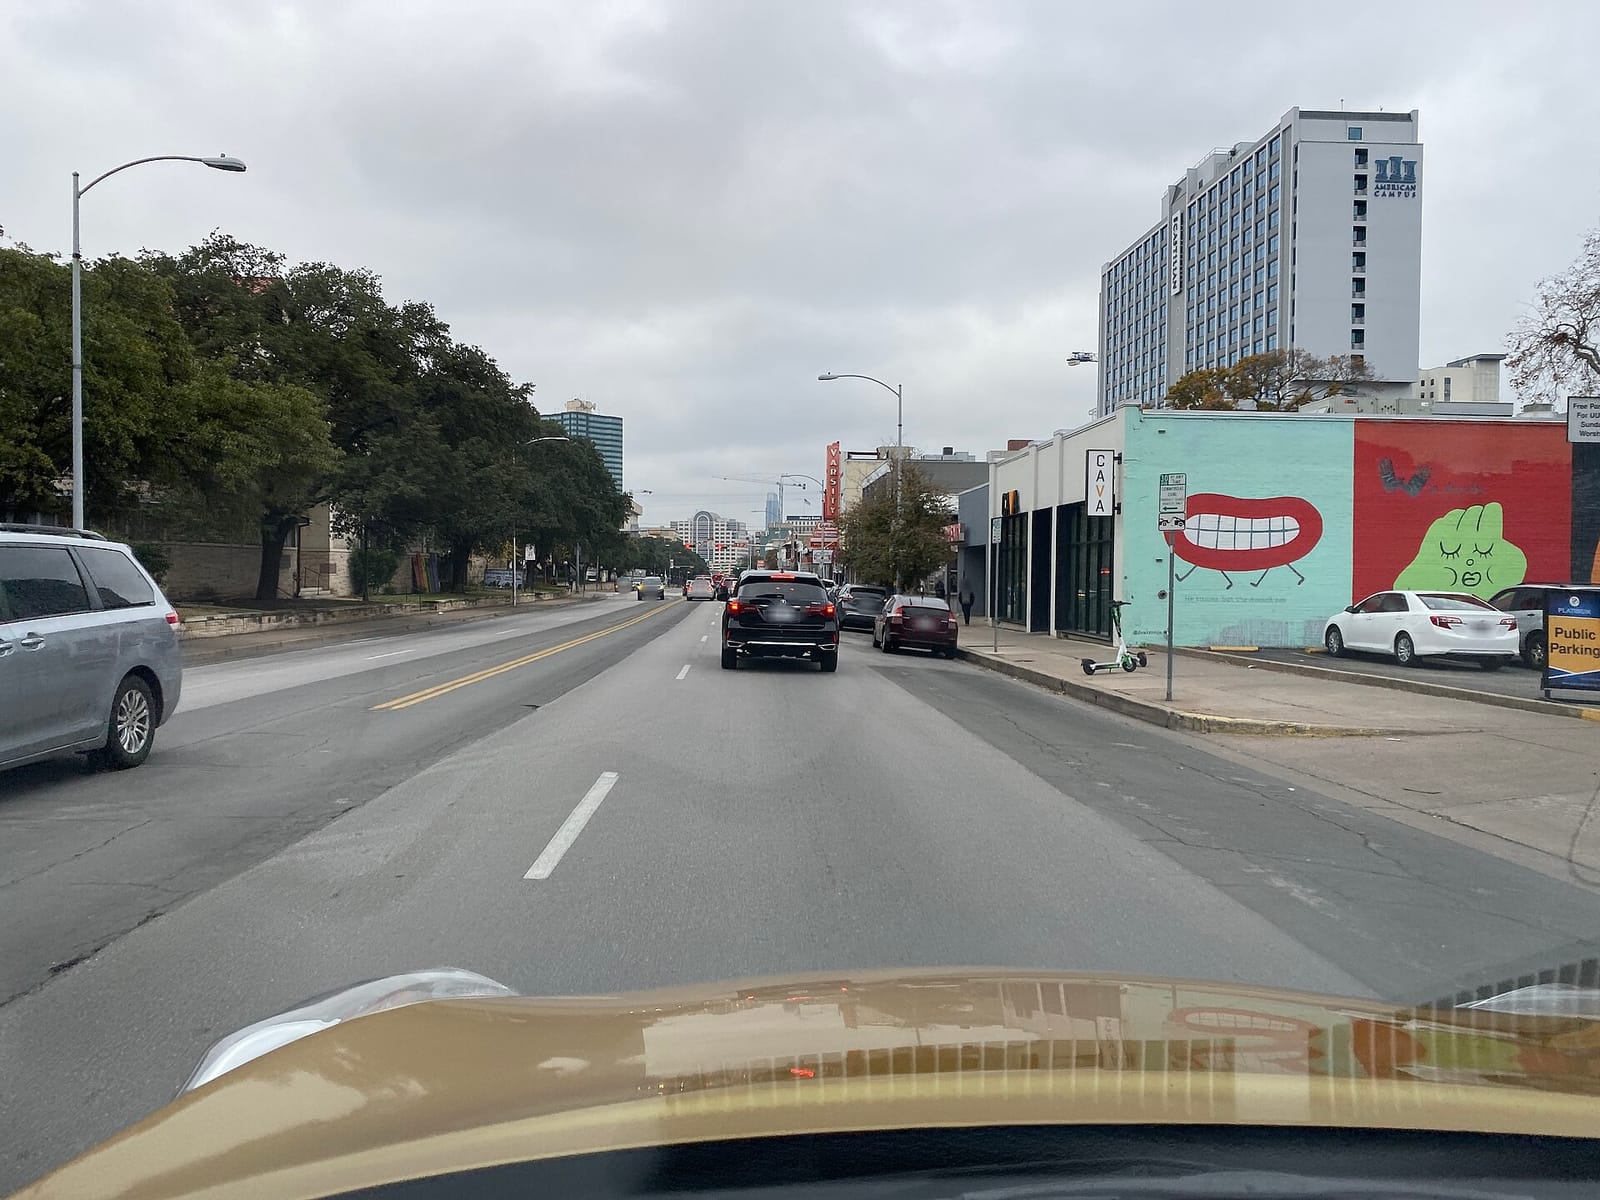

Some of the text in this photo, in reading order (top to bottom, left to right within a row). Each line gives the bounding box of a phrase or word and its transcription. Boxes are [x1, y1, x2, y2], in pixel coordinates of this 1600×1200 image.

[1374, 183, 1417, 191] AMERICAN
[1374, 190, 1417, 198] CAMPUS
[829, 448, 838, 514] VARSITY
[1095, 454, 1106, 513] CAVA
[1555, 627, 1597, 640] Public
[1550, 642, 1600, 659] Parking
